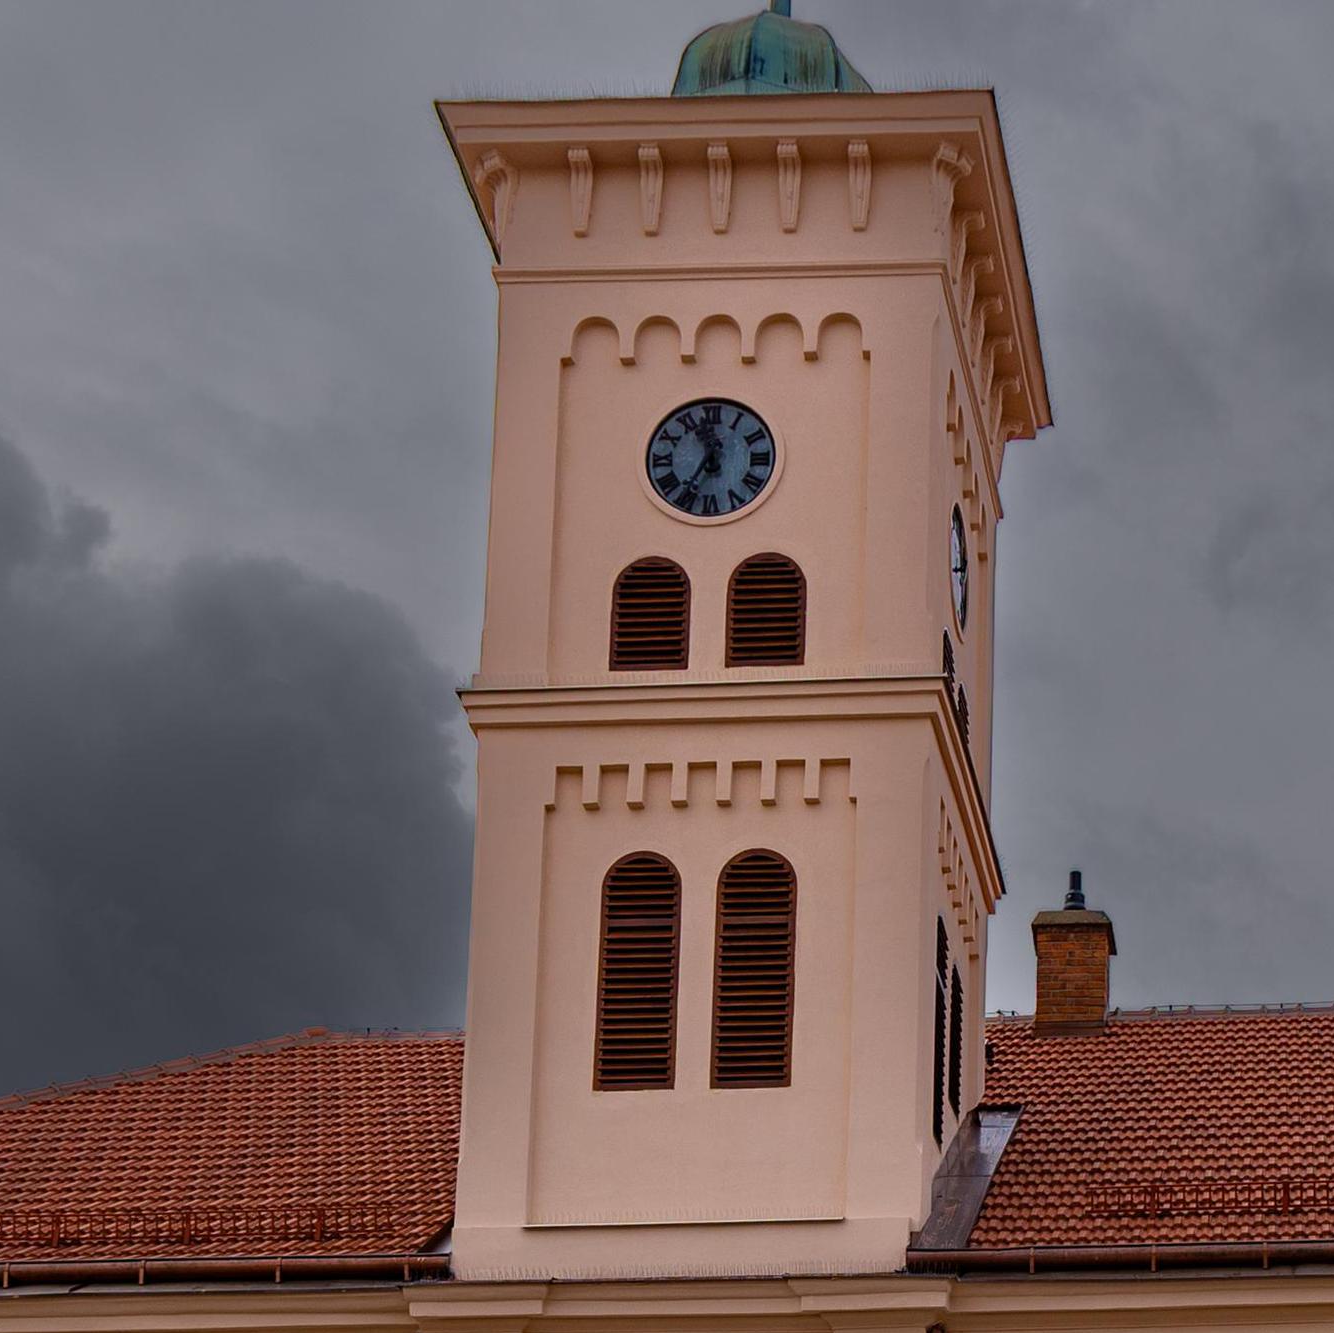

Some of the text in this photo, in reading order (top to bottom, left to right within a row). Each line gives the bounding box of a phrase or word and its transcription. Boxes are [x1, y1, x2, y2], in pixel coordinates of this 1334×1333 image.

[676, 411, 699, 434] XI
[702, 405, 722, 425] XII
[729, 411, 744, 431] I
[659, 428, 683, 448] X
[743, 427, 766, 447] II
[653, 451, 673, 468] IX
[750, 450, 770, 467] III
[702, 493, 720, 513] VI
[727, 488, 747, 509] V
